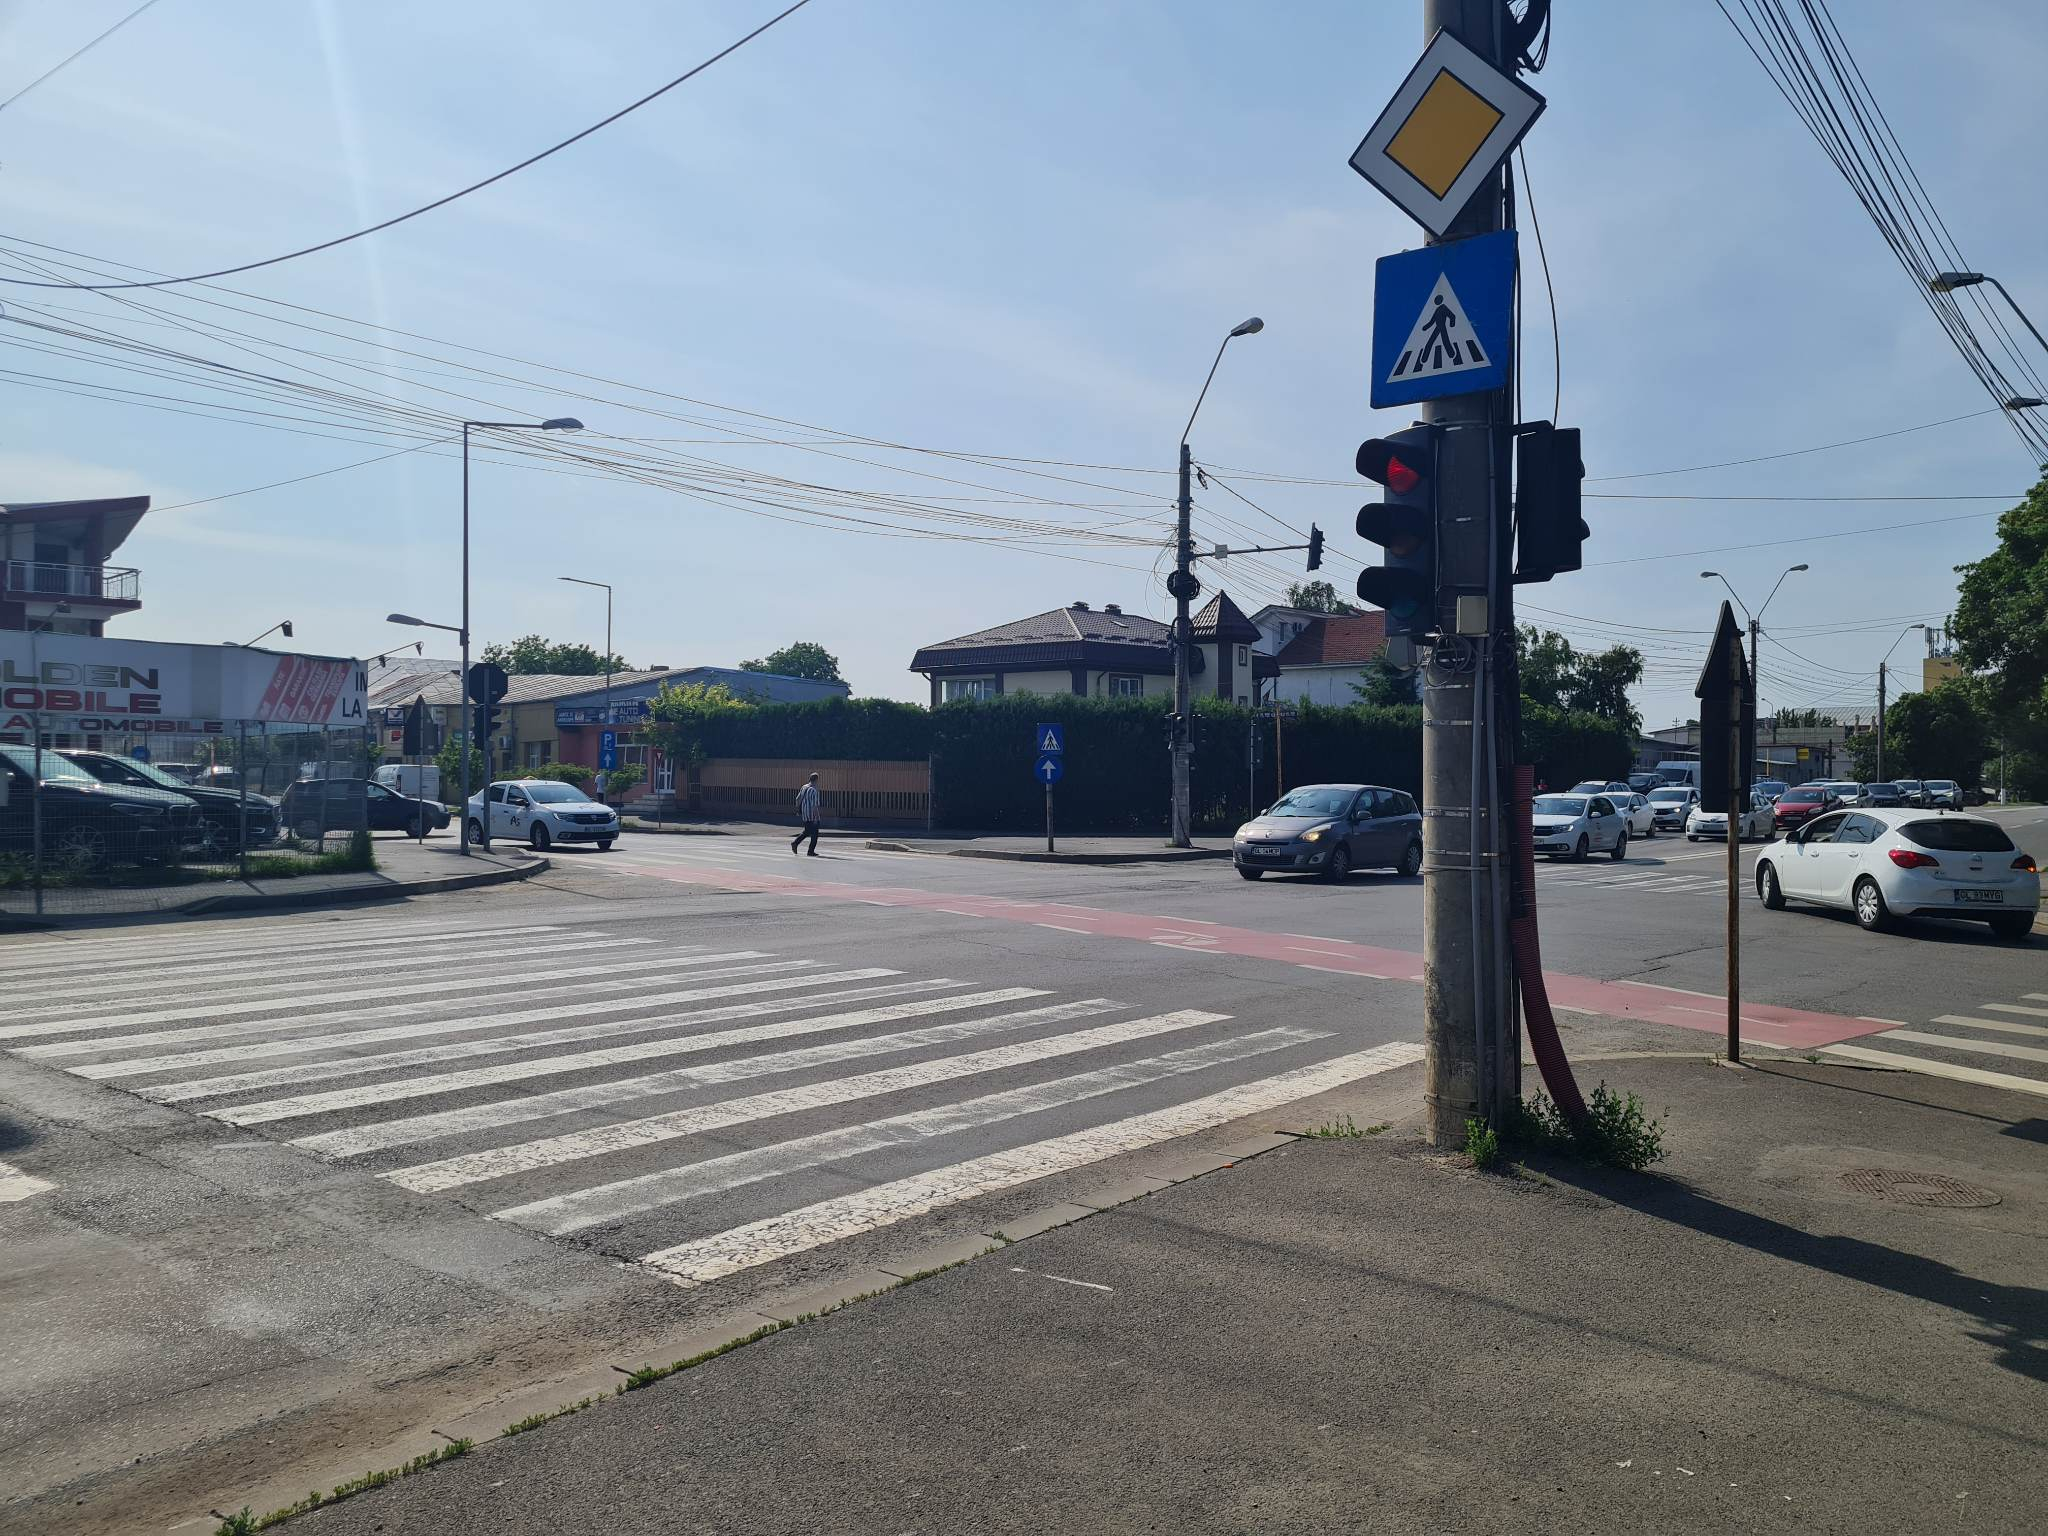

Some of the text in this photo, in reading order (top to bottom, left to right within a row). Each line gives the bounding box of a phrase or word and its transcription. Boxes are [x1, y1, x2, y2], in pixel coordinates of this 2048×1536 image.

[0, 660, 159, 689] LDEN
[0, 687, 161, 714] OBILE
[342, 697, 362, 718] LA
[604, 734, 612, 746] P
